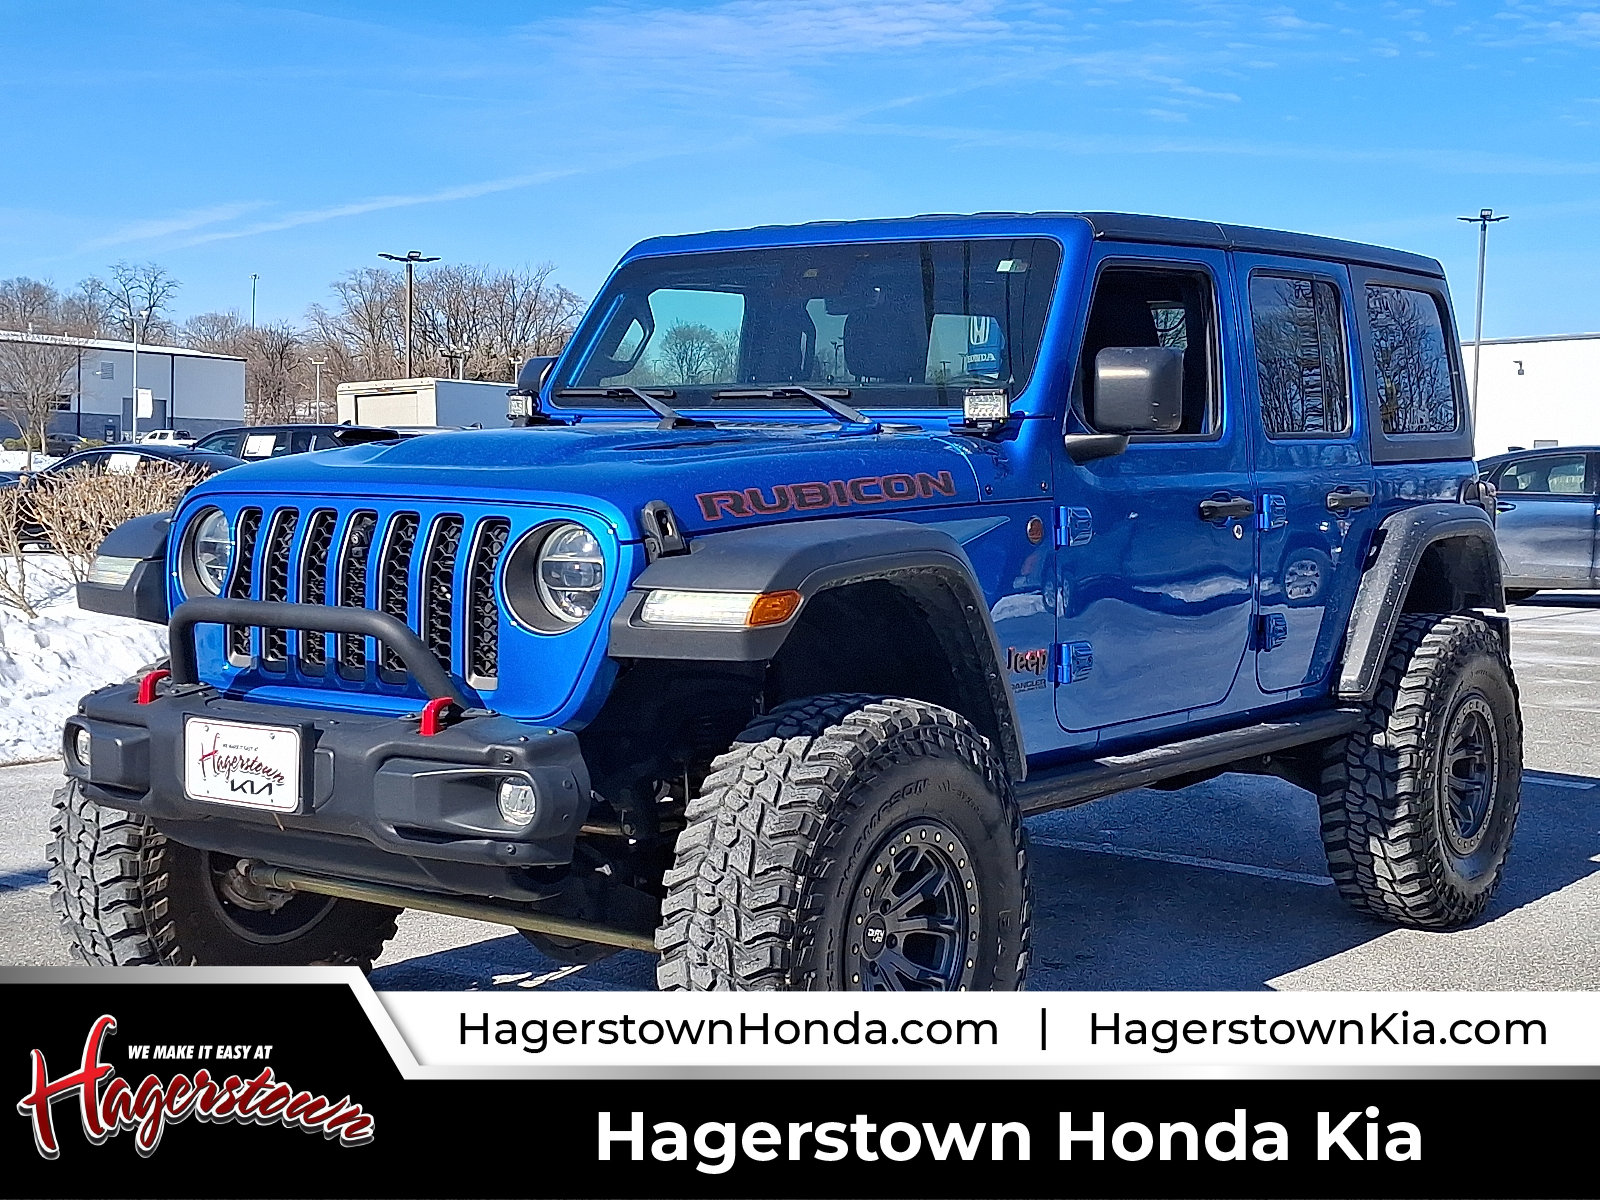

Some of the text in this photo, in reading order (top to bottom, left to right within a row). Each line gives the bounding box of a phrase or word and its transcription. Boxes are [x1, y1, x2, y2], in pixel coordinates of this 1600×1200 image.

[966, 353, 997, 364] HONDA
[696, 470, 957, 521] RUBICON
[1006, 646, 1048, 676] Jeep
[199, 732, 285, 786] Hagerstown
